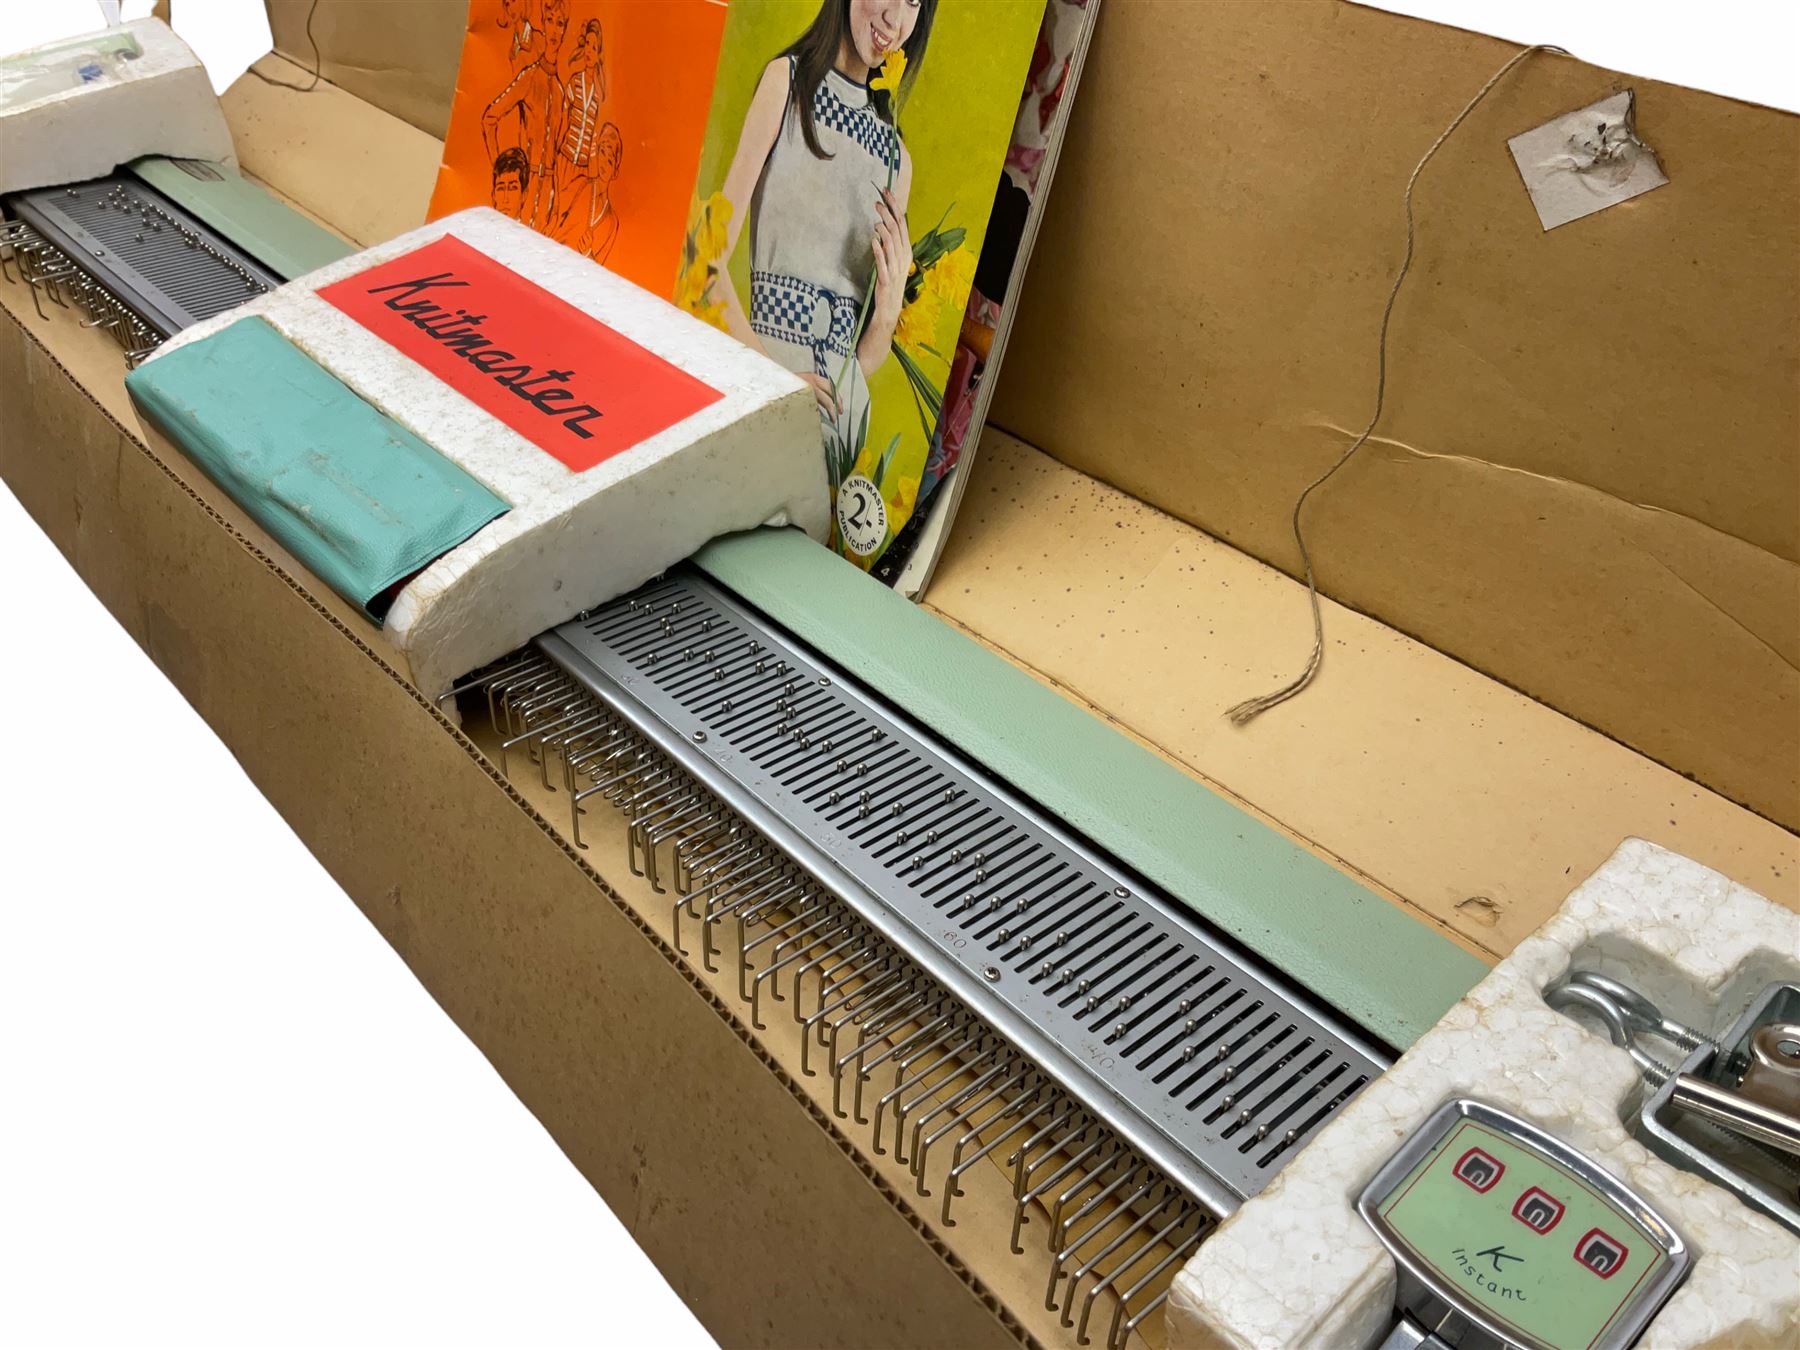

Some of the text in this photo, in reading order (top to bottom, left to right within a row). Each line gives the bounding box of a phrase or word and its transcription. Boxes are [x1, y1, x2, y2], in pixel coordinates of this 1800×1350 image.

[367, 272, 604, 440] Knitmaster
[842, 479, 885, 527] A KNITMASTER
[839, 510, 878, 552] PUBLICATION
[1476, 1245, 1525, 1272] K
